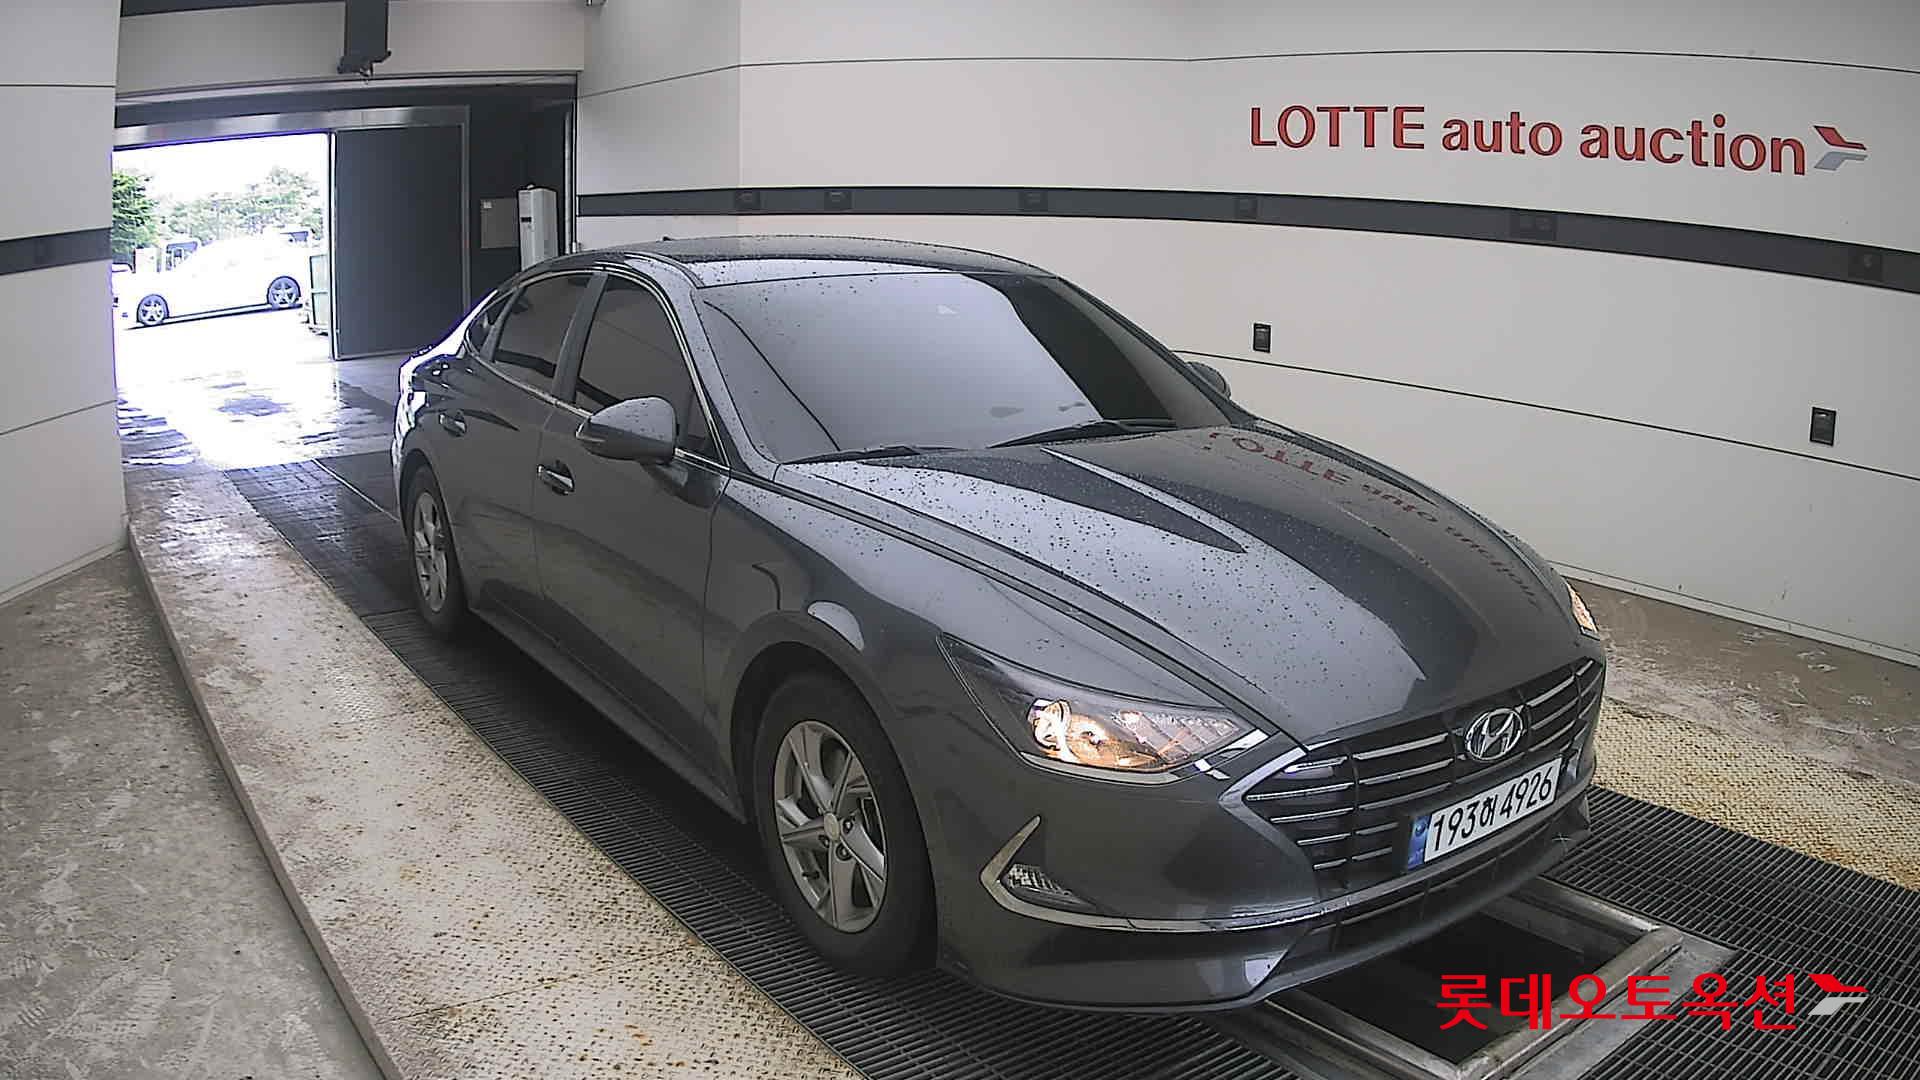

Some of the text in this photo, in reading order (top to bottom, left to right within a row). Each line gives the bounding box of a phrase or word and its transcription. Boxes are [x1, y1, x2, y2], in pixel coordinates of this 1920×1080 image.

[1250, 105, 1807, 177] LOTTE auto auction
